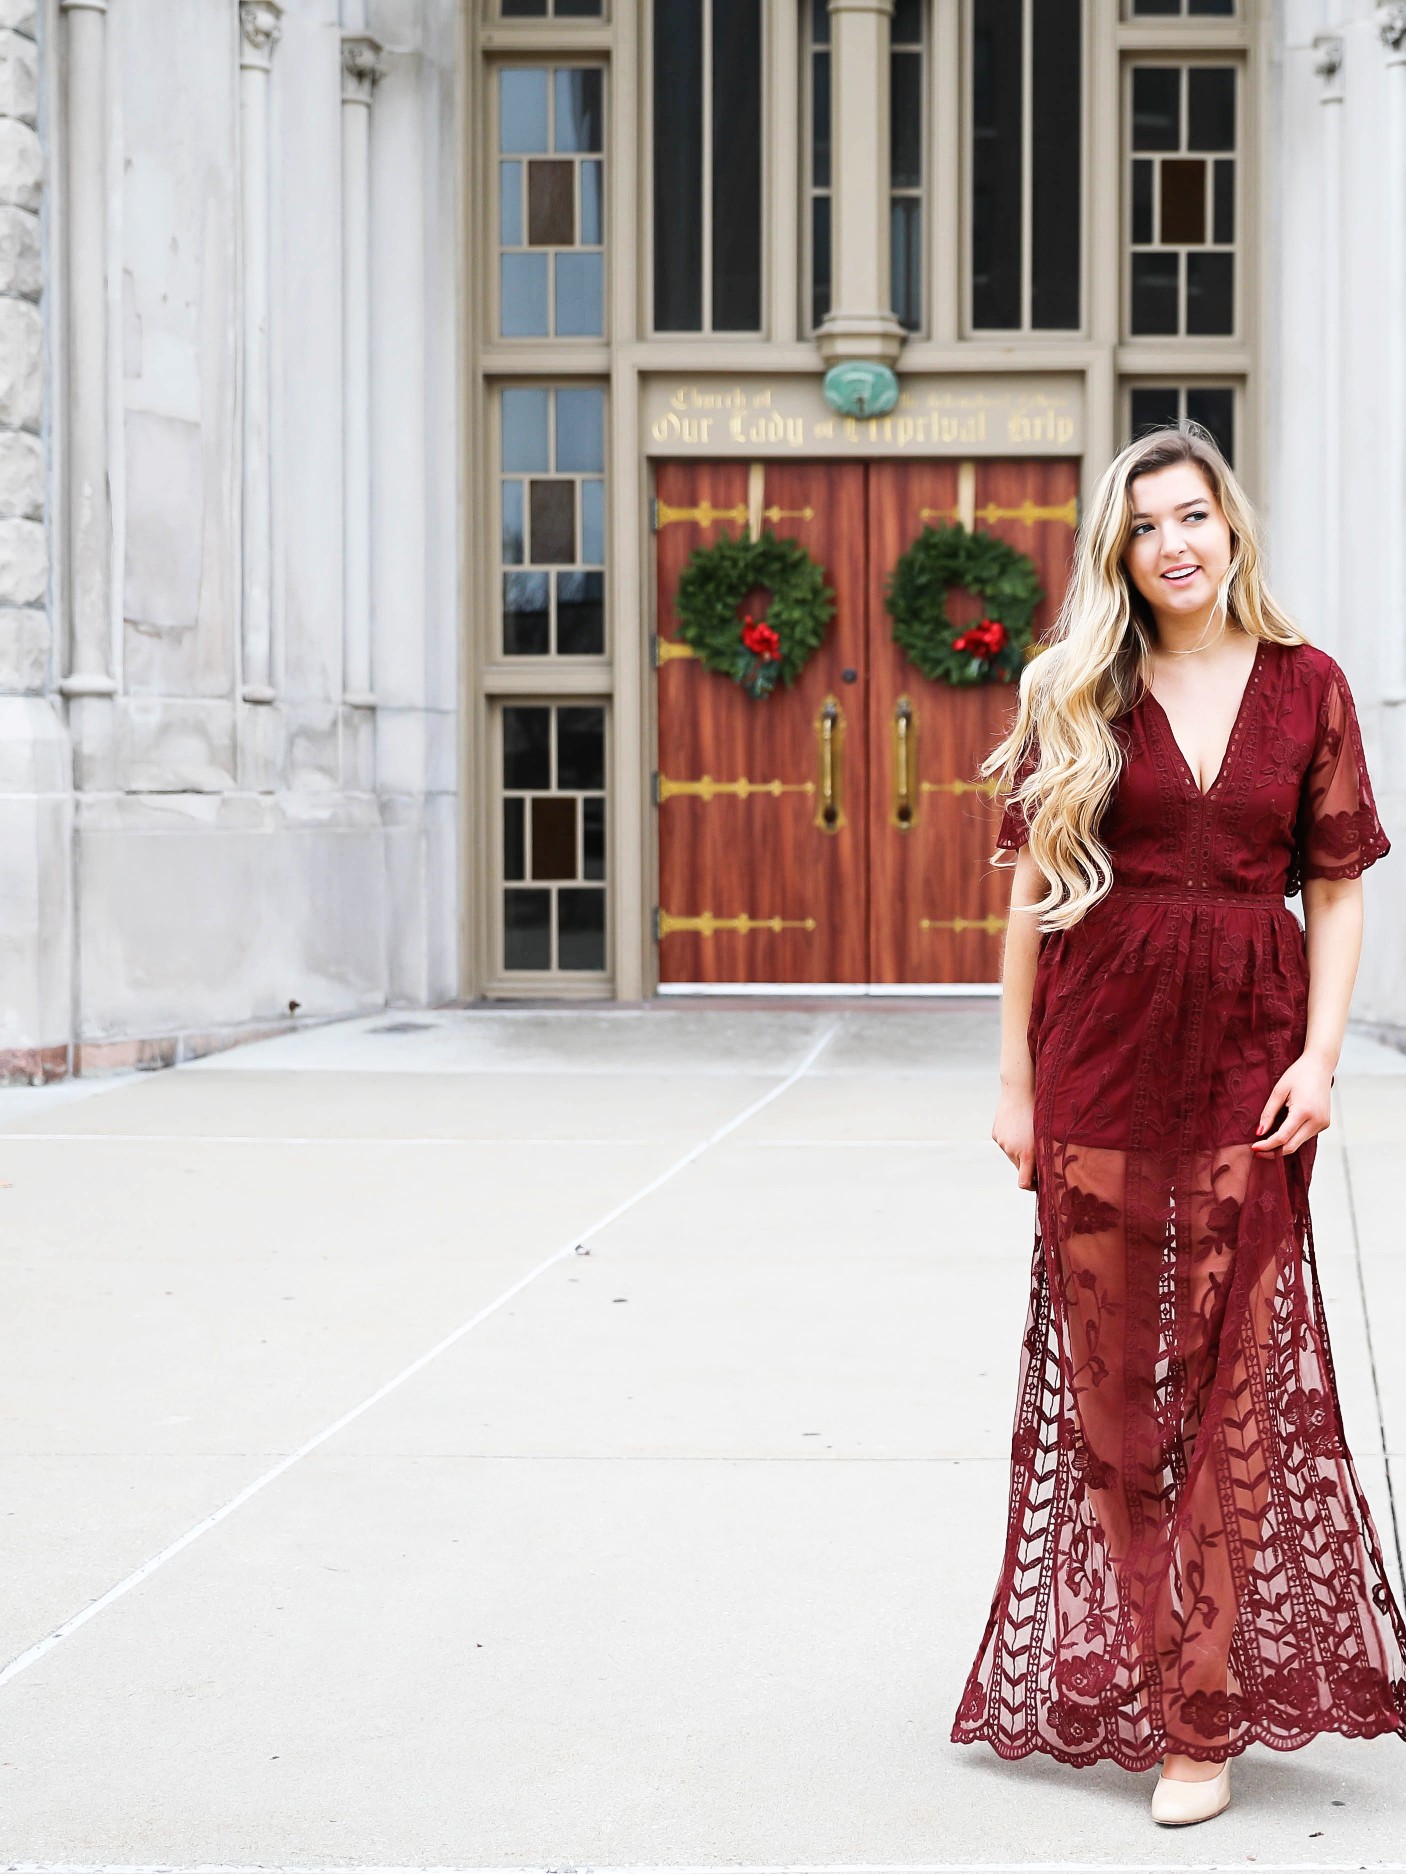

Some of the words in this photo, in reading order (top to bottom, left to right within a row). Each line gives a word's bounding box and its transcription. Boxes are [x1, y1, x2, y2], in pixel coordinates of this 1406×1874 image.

[671, 387, 746, 409] Church
[753, 388, 773, 407] of
[652, 411, 711, 443] Our
[729, 409, 804, 447] Lady
